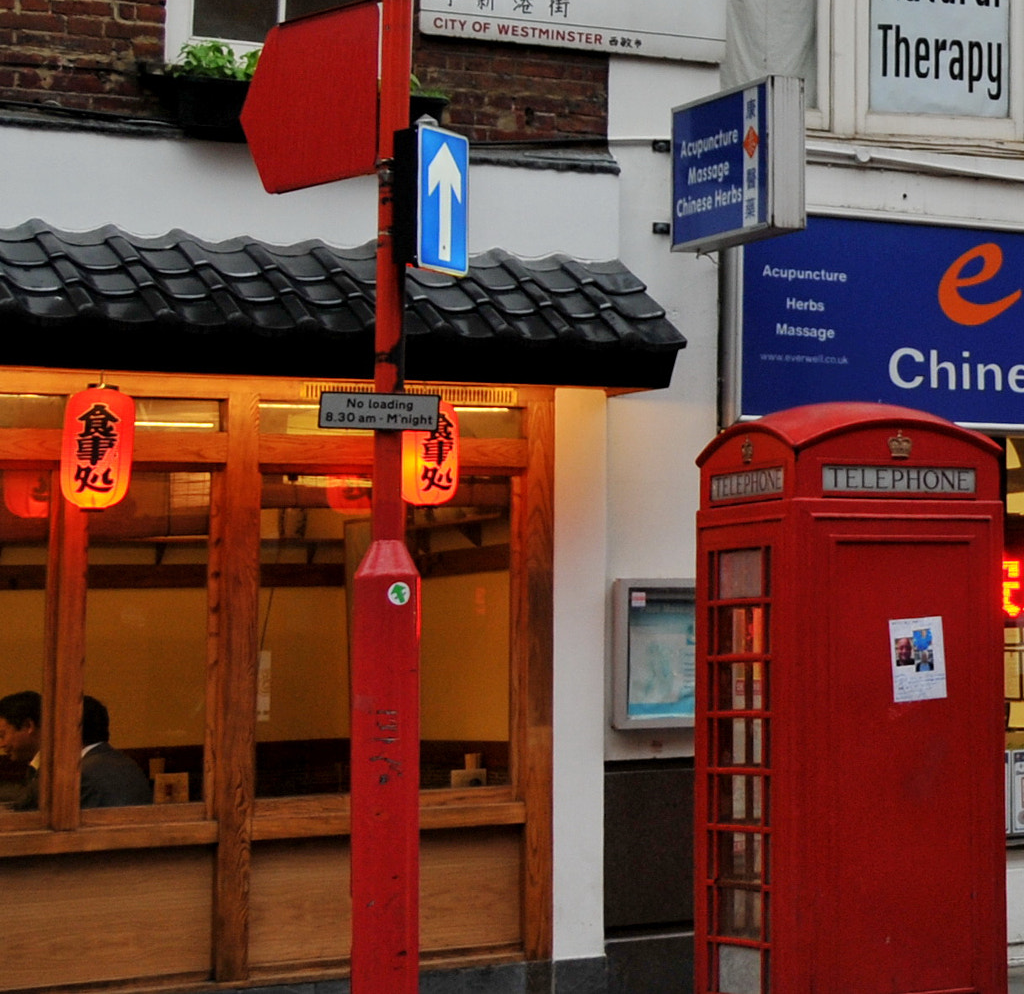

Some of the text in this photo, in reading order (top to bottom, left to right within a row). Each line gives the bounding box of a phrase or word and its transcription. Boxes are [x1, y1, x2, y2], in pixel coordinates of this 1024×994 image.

[433, 17, 603, 45] CITY OF WESTMINSTER
[877, 23, 1002, 101] Therapy
[680, 128, 739, 158] Acupuncture
[687, 160, 730, 185] Massage
[676, 184, 743, 218] Chinese Herbs
[762, 264, 847, 282] Acupuncture
[786, 297, 825, 312] Herbs
[775, 323, 836, 341] Massage
[346, 398, 413, 411] No loading
[325, 412, 355, 423] 8.30
[73, 402, 120, 493] 食事処
[714, 467, 783, 498] TELEPHONE
[828, 467, 970, 492] TELEPHONE
